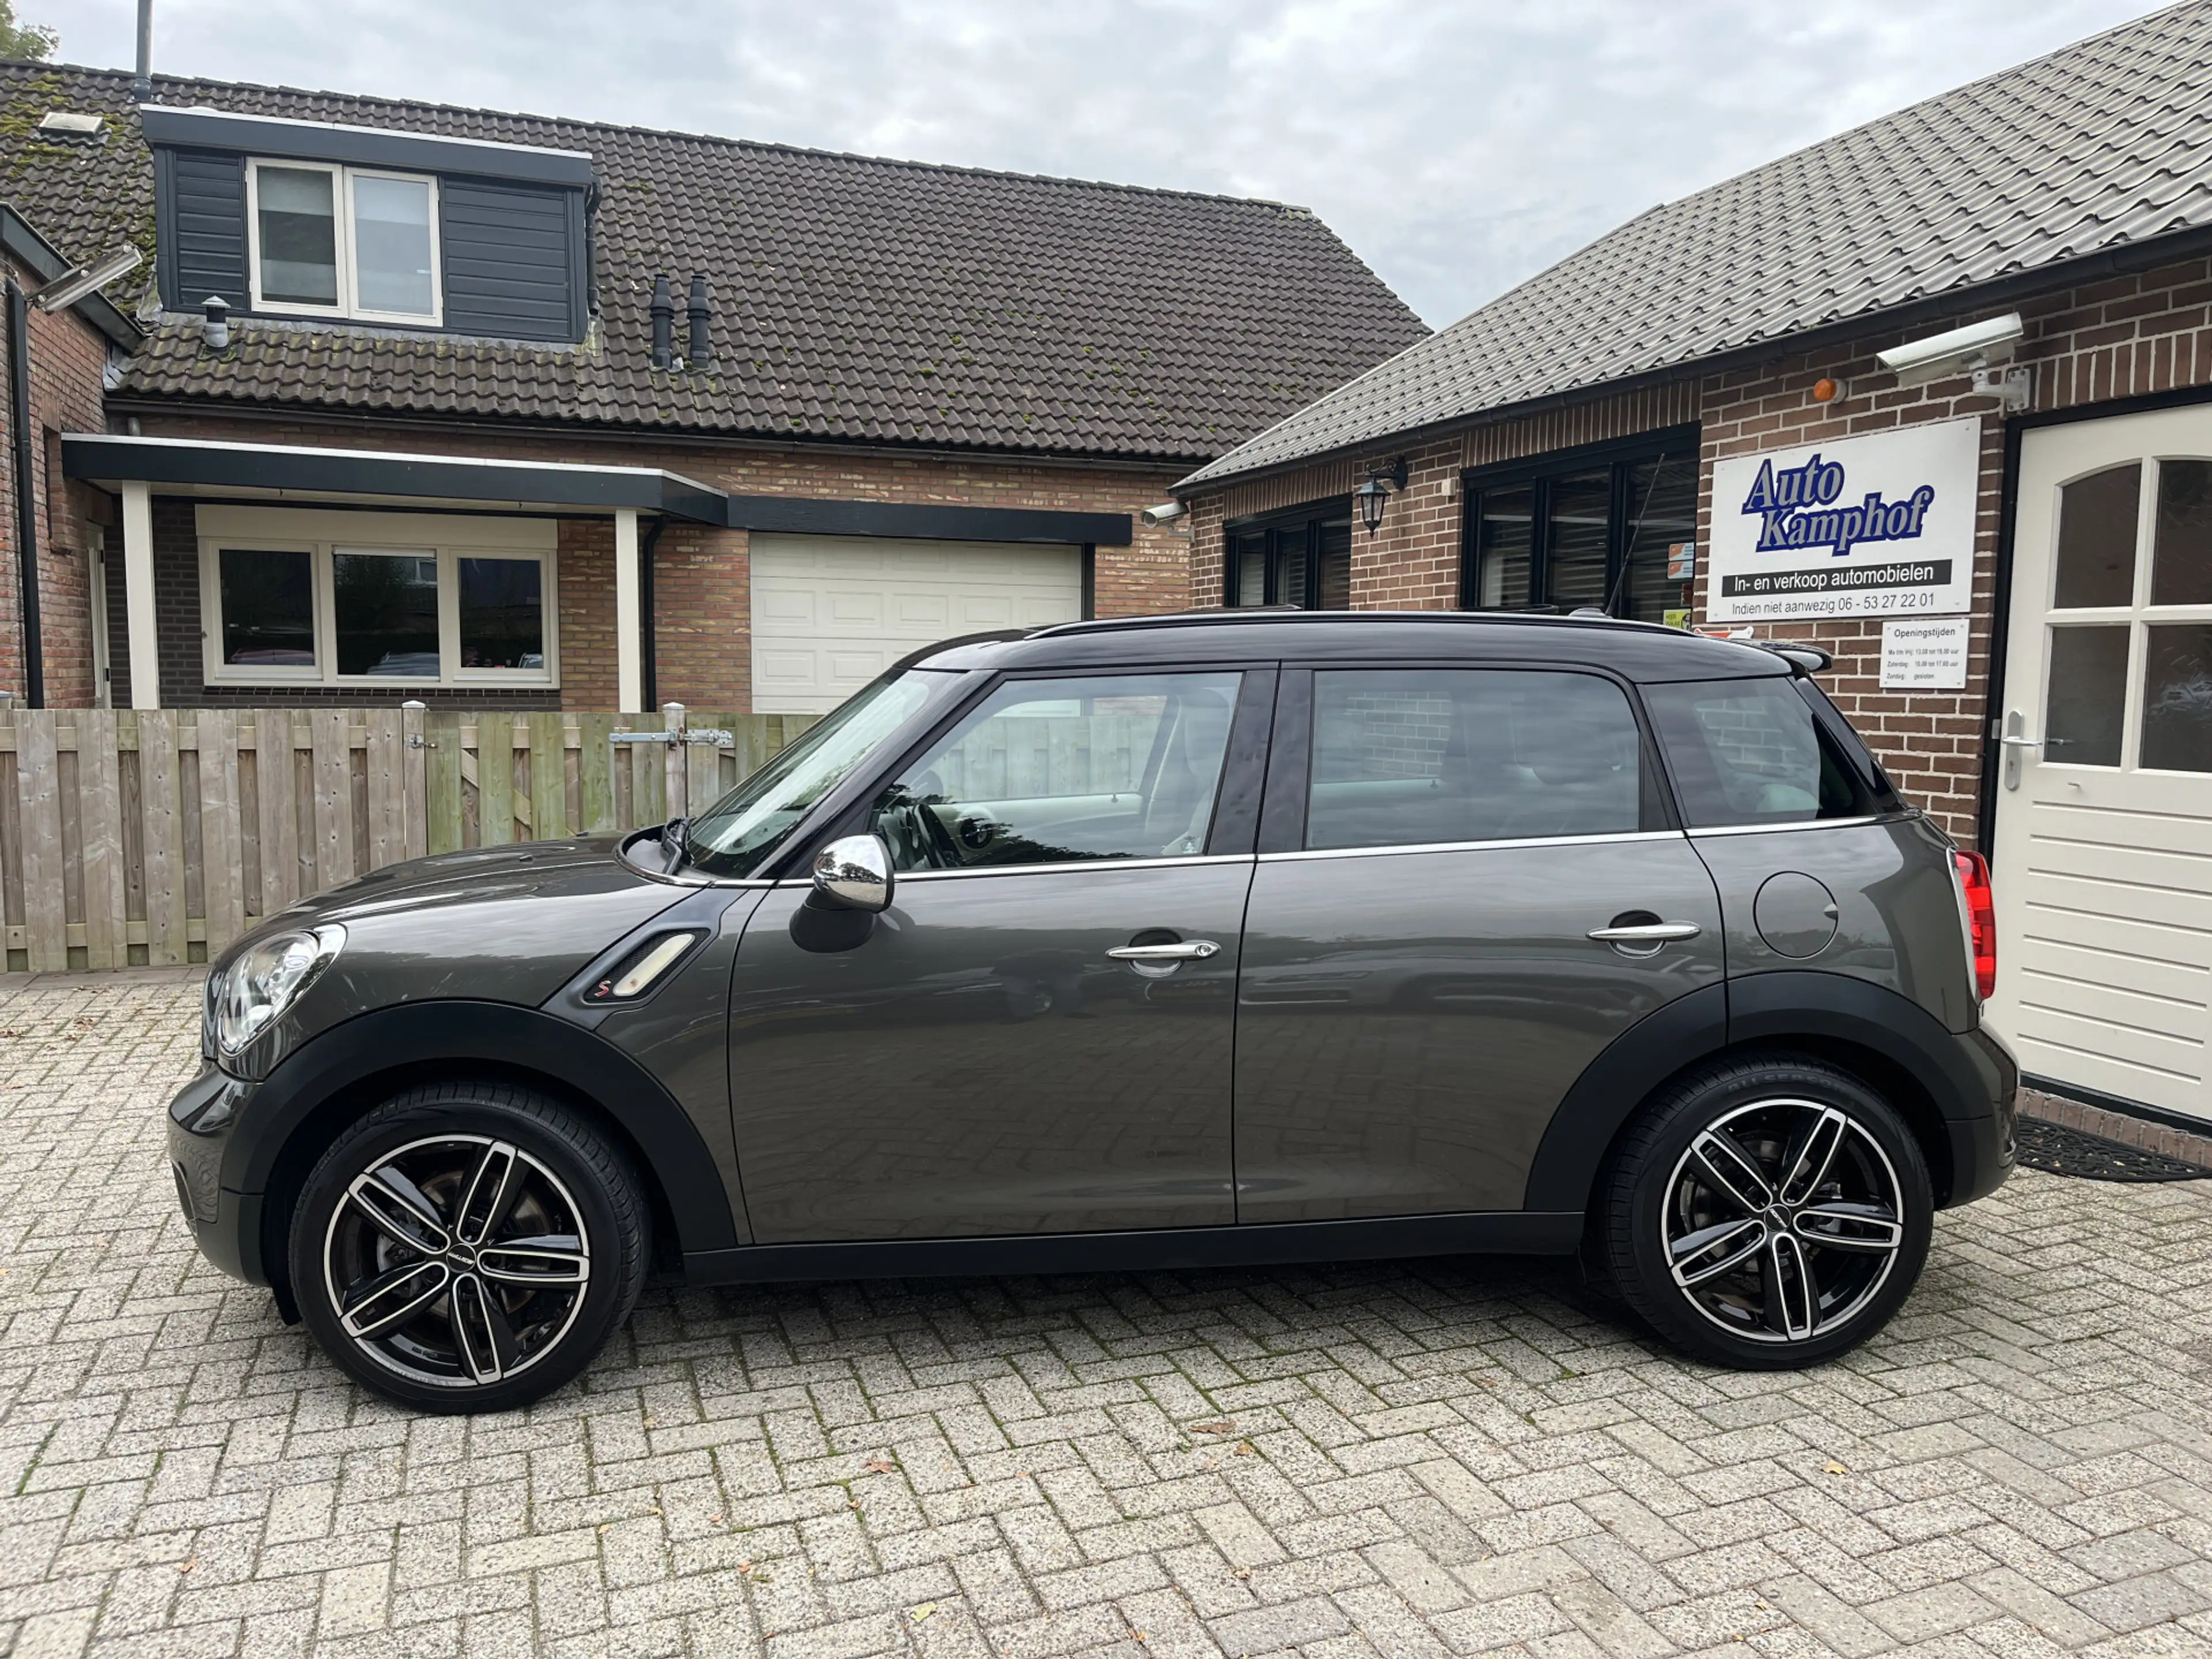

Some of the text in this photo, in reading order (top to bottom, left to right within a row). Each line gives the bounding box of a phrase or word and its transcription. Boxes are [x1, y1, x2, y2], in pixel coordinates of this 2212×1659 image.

[1741, 453, 1845, 514] Auto
[1755, 485, 1934, 556] Kamphof
[1734, 564, 1933, 592] In- en verkoop automobielen
[1733, 603, 1761, 615] Indien
[1764, 601, 1782, 613] niet
[1784, 599, 1835, 615] aanwezig
[1838, 597, 1852, 611] 06
[1863, 596, 1878, 609] 53
[1881, 595, 1897, 608] 27
[1900, 594, 1916, 608] 22
[1919, 592, 1934, 607] 01
[1894, 627, 1956, 639] Openingstijden
[594, 980, 612, 997] S
